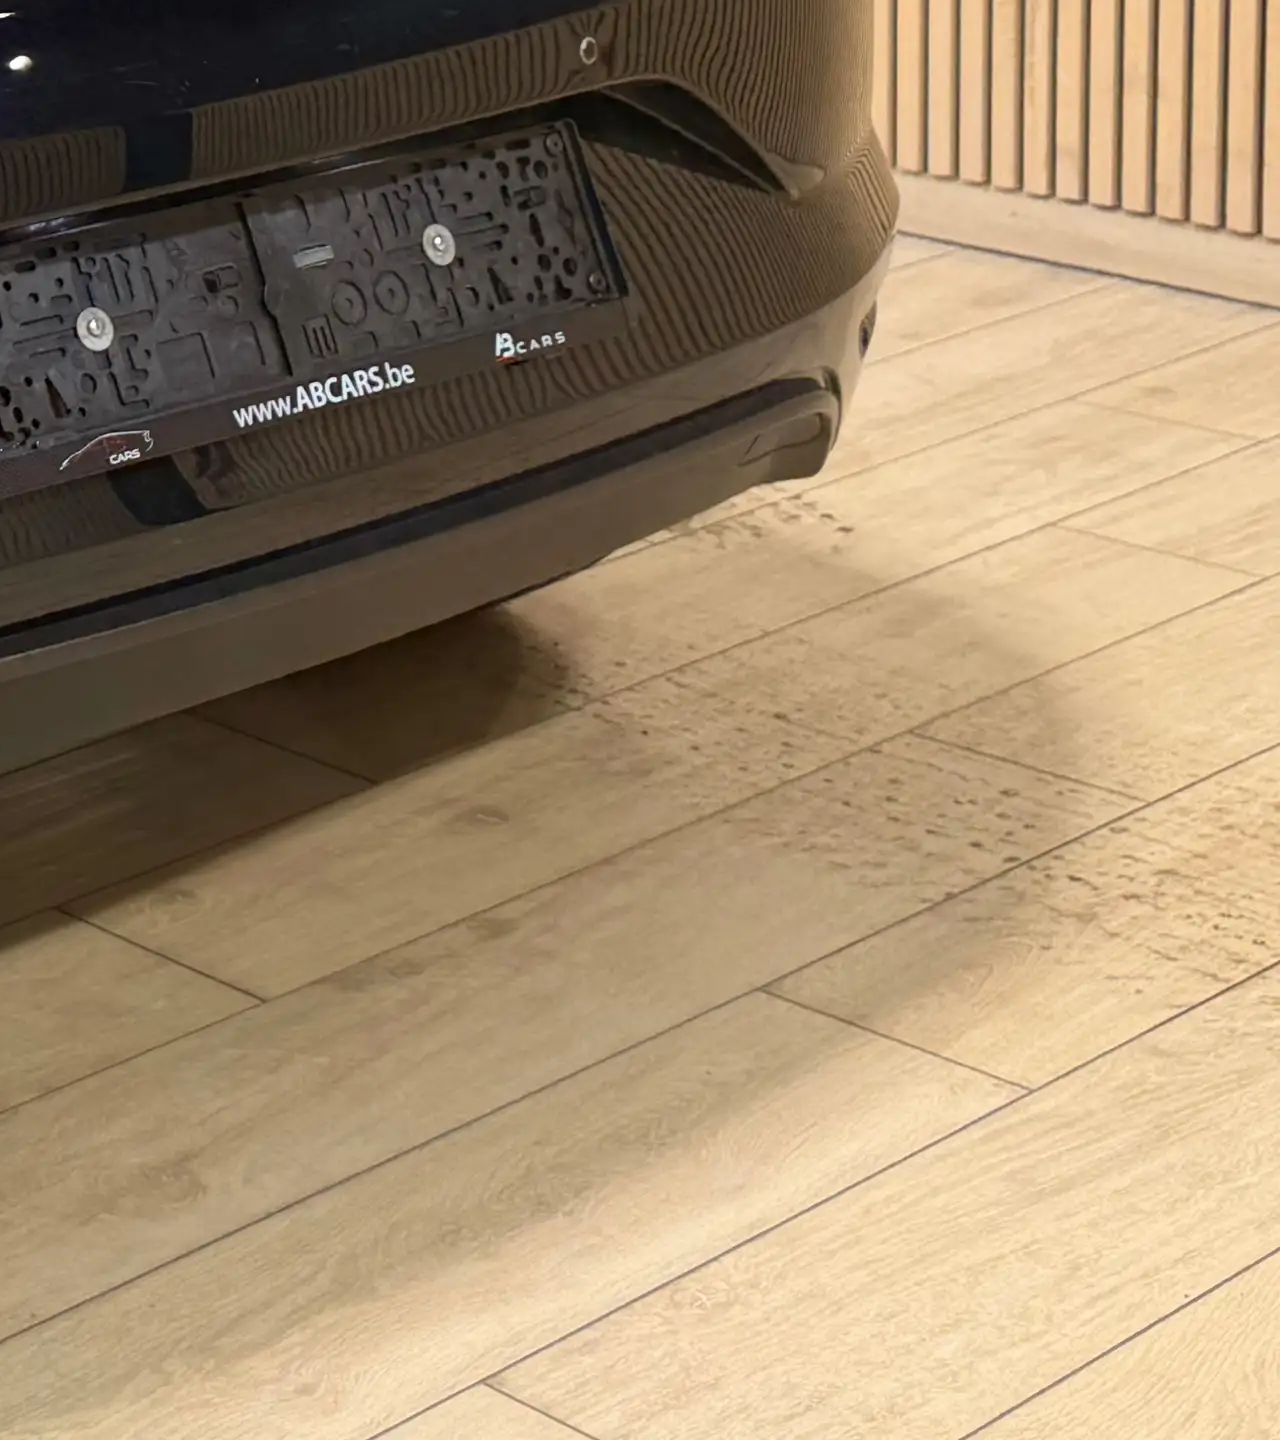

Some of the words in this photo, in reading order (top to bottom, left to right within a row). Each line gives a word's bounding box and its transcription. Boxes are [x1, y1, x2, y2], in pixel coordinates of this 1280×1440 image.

[516, 331, 566, 354] CARS
[232, 362, 416, 428] www.ABCARS.be
[109, 448, 141, 465] CARS
